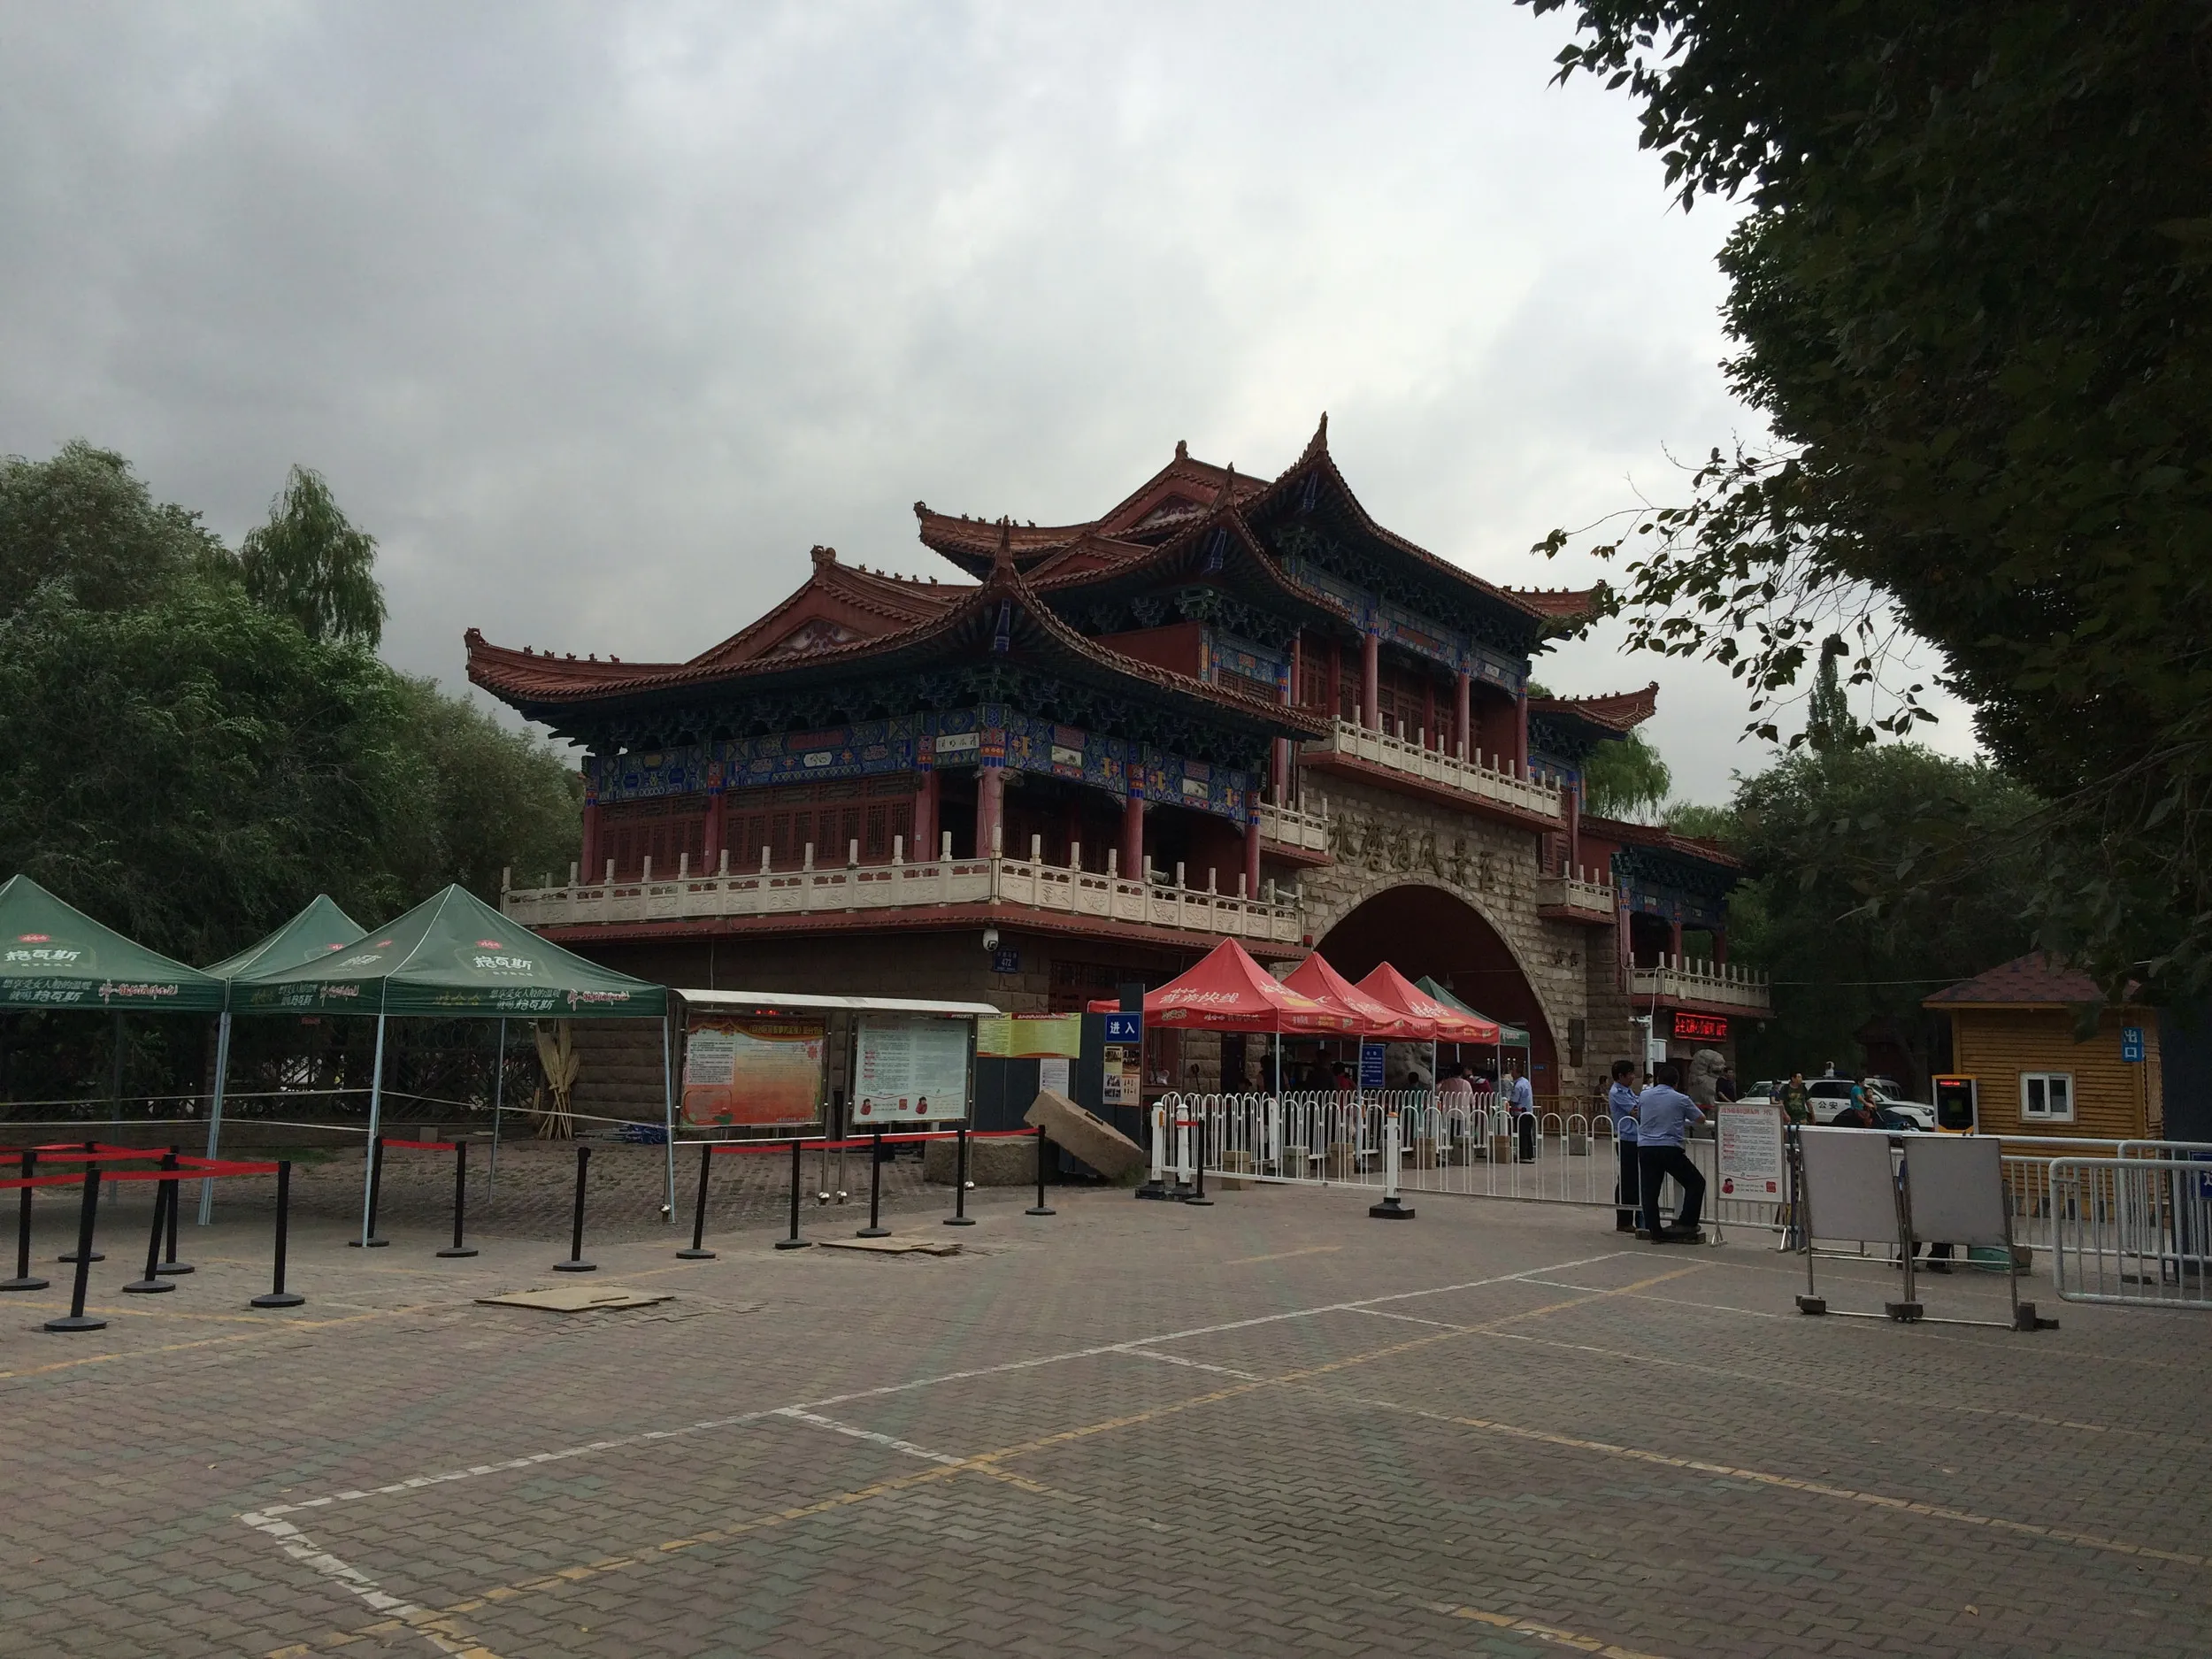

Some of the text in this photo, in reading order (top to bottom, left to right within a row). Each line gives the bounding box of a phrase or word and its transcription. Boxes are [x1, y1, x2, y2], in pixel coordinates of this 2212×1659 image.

[4, 949, 81, 962] 格瓦斯
[472, 956, 533, 971] 格瓦斯
[1001, 958, 1012, 967] 472
[1109, 1021, 1136, 1034] 进入
[2124, 1029, 2139, 1059] 出口
[1817, 1101, 1838, 1110] 公安
